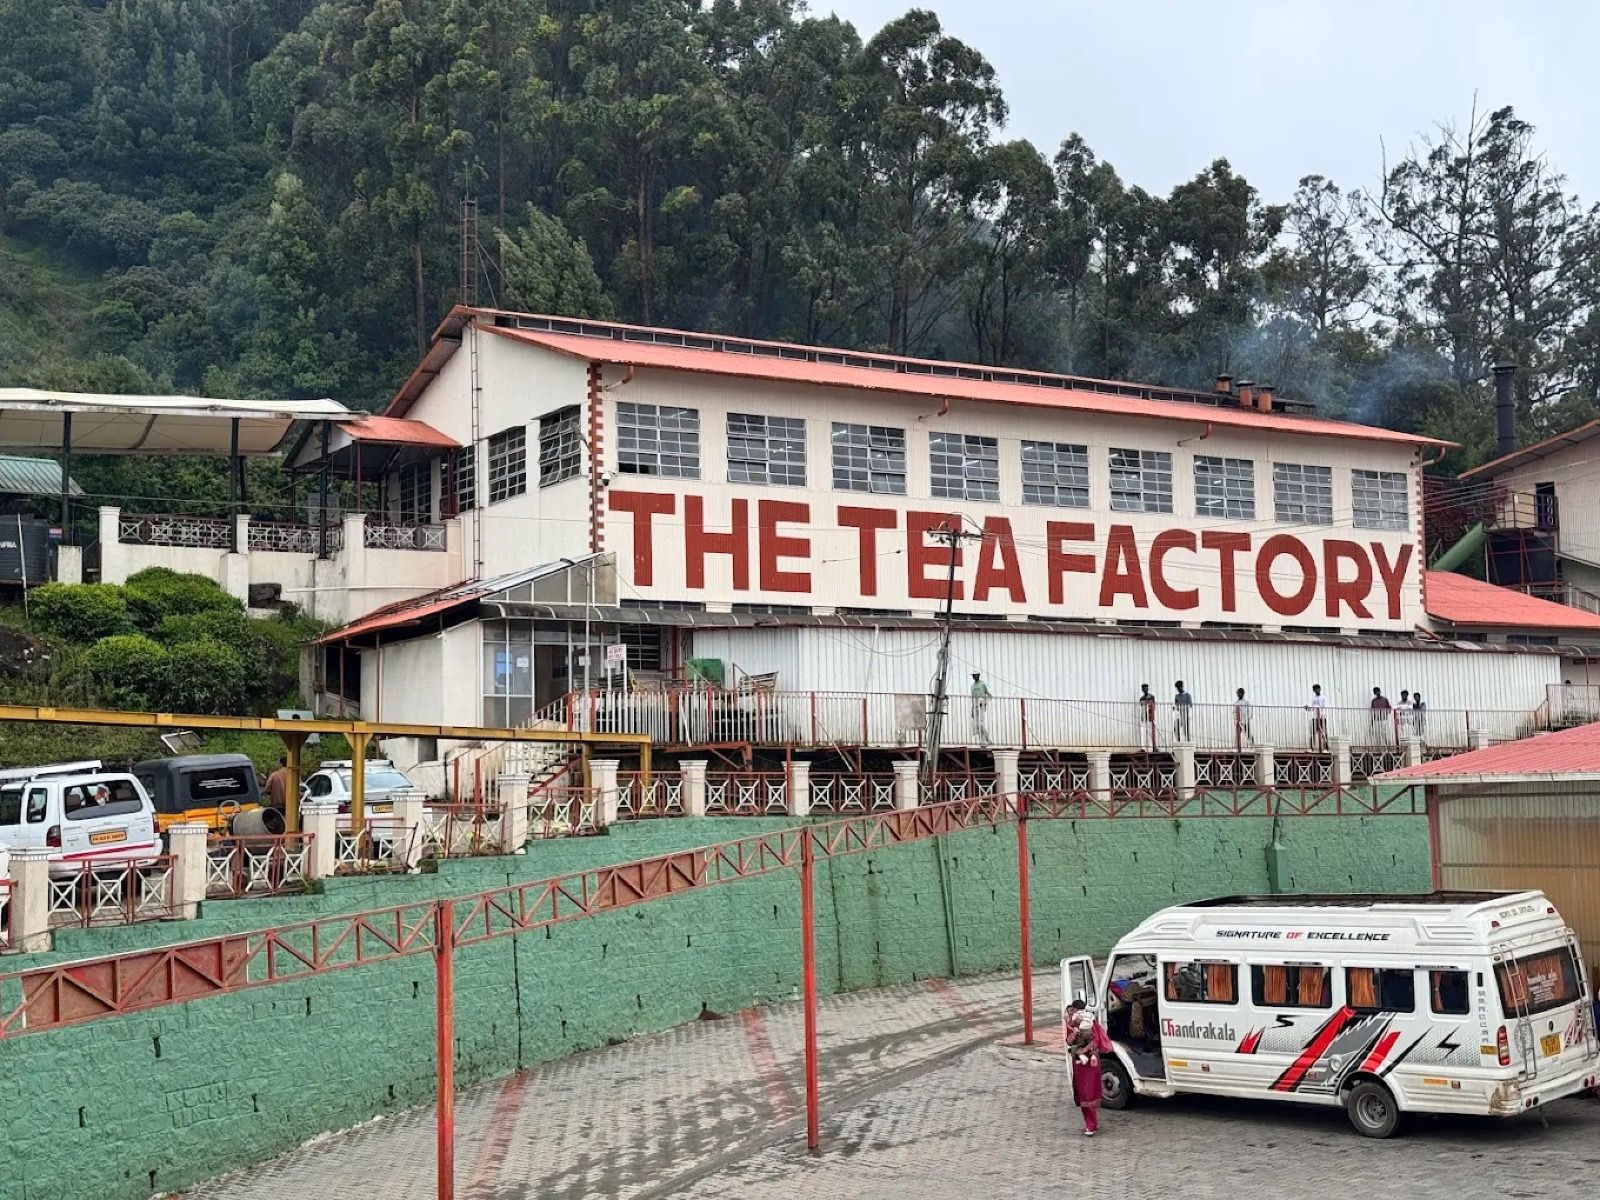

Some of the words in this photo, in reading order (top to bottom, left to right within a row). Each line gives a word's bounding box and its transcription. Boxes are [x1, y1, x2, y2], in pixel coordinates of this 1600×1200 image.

[609, 491, 811, 593] THE
[838, 505, 1026, 603] TEA
[1047, 521, 1413, 619] FACTORY
[1216, 930, 1282, 940] SIGNATURE
[1285, 931, 1304, 940] OF
[1306, 931, 1391, 942] EXCELLENCE
[1160, 1018, 1236, 1041] Chandrakala
